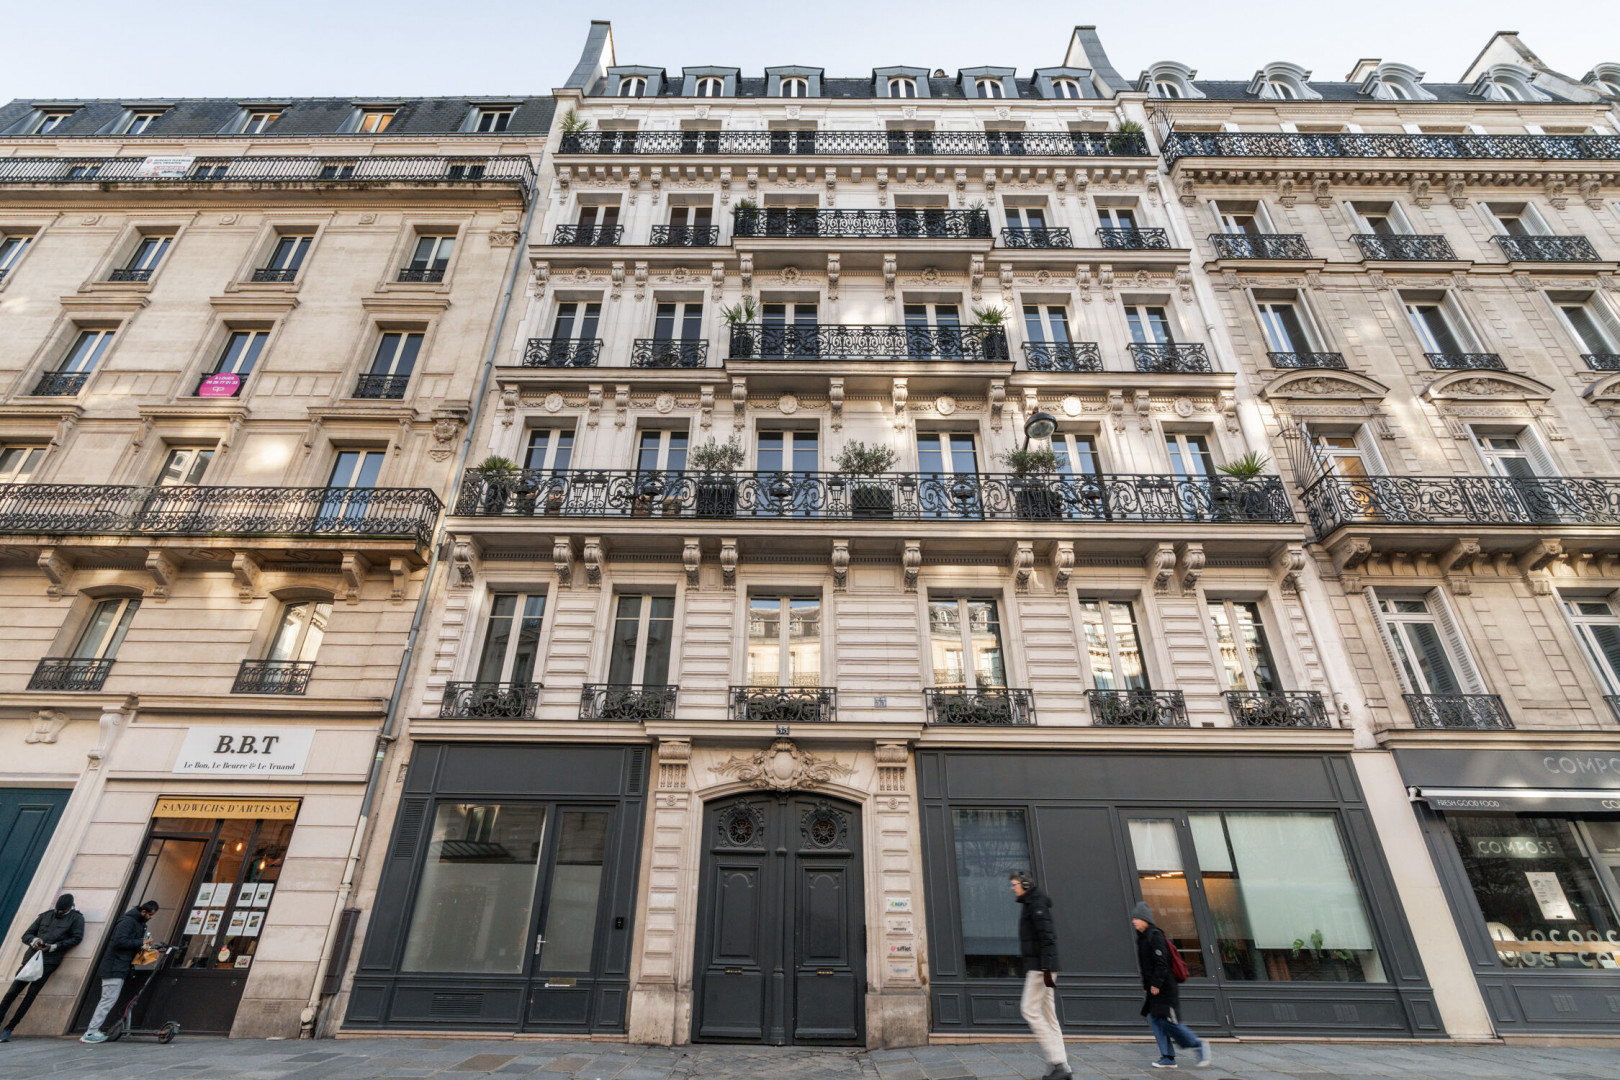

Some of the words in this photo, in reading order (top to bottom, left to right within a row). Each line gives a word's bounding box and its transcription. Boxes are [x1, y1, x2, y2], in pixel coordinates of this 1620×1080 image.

[213, 735, 279, 754] B.B.T
[1543, 757, 1620, 774] COMPO
[162, 803, 225, 812] SANDWICHS
[1456, 799, 1480, 807] GOOD
[1601, 800, 1620, 809] CO
[1477, 841, 1556, 854] COMPOSE
